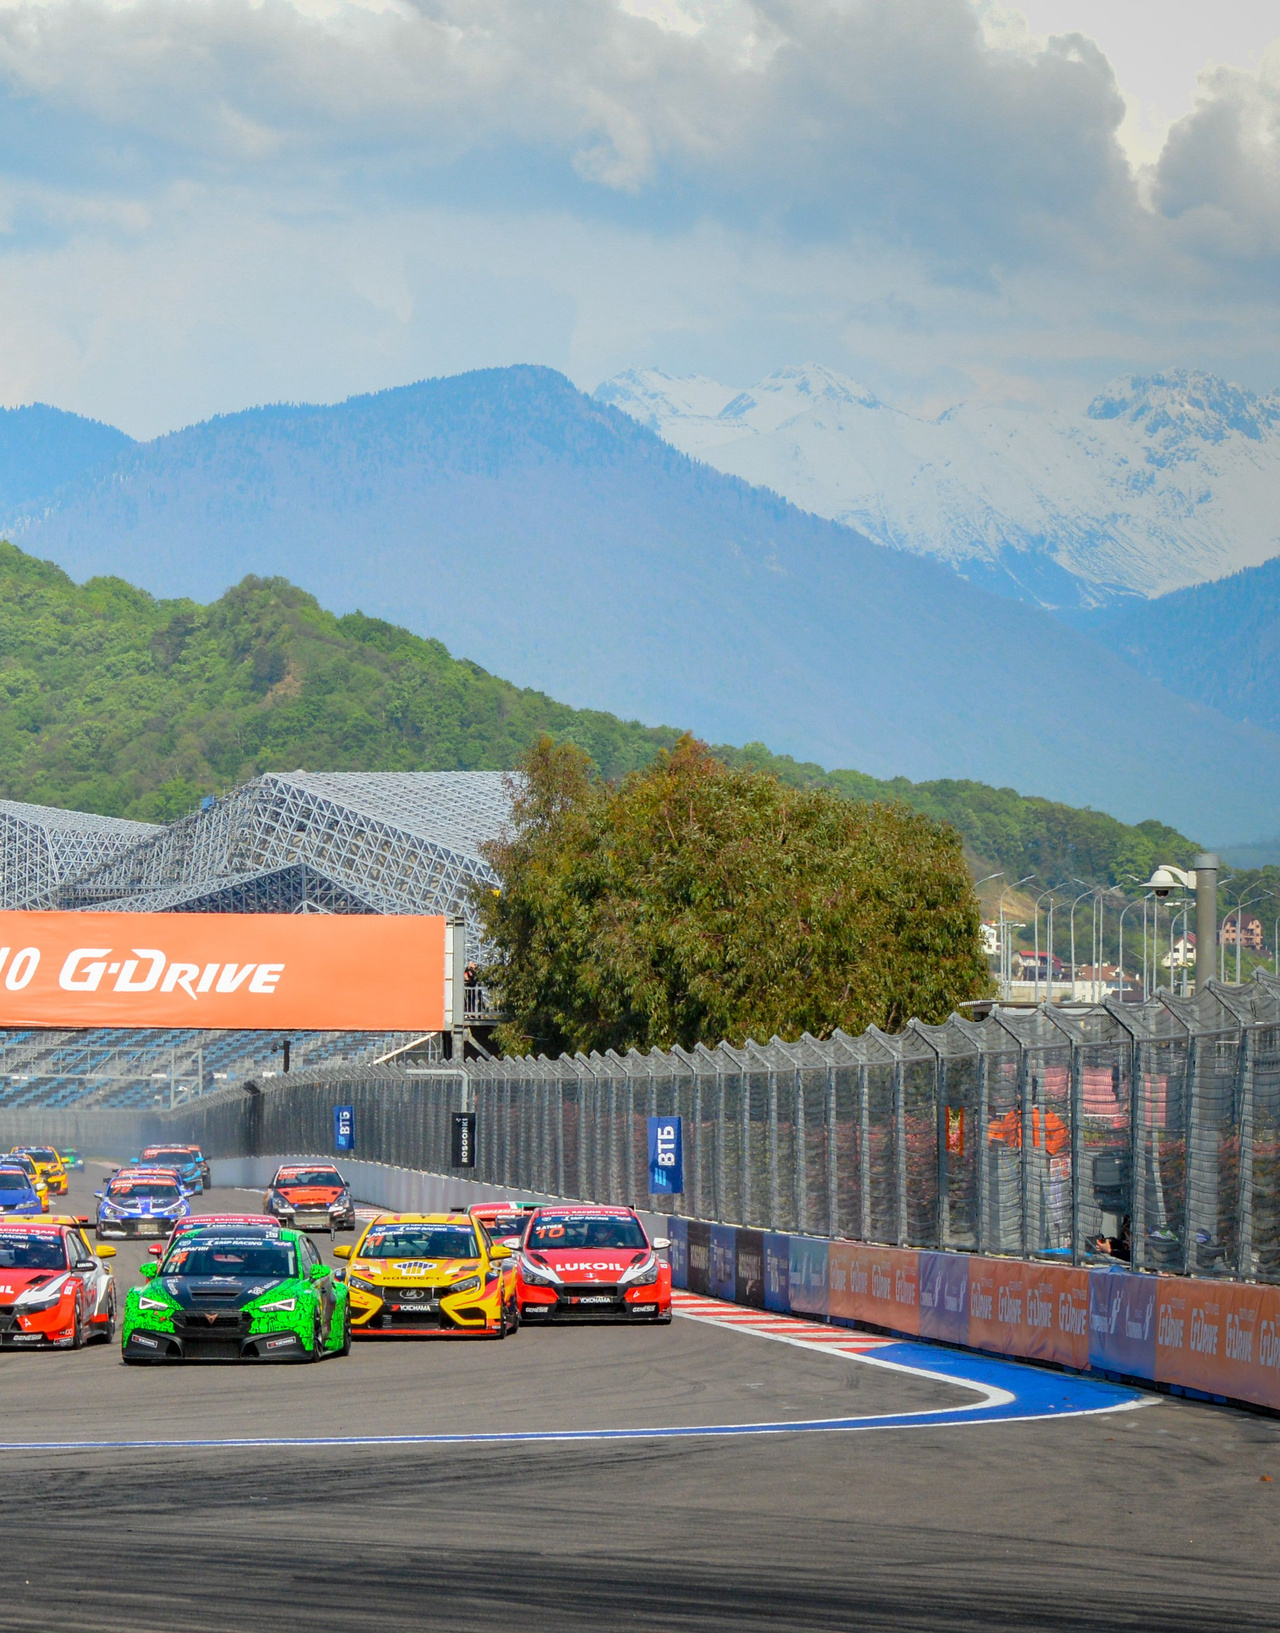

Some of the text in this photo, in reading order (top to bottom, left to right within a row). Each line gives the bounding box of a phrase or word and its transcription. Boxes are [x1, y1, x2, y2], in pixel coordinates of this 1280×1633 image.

[339, 1111, 351, 1135] ВТБ
[461, 1118, 469, 1163] ROSGONKI
[657, 1126, 675, 1166] ВТБ
[536, 1227, 565, 1239] 10
[367, 1236, 384, 1247] 11
[556, 1262, 624, 1272] LUKOIL
[400, 1304, 431, 1312] YOKOHAMA
